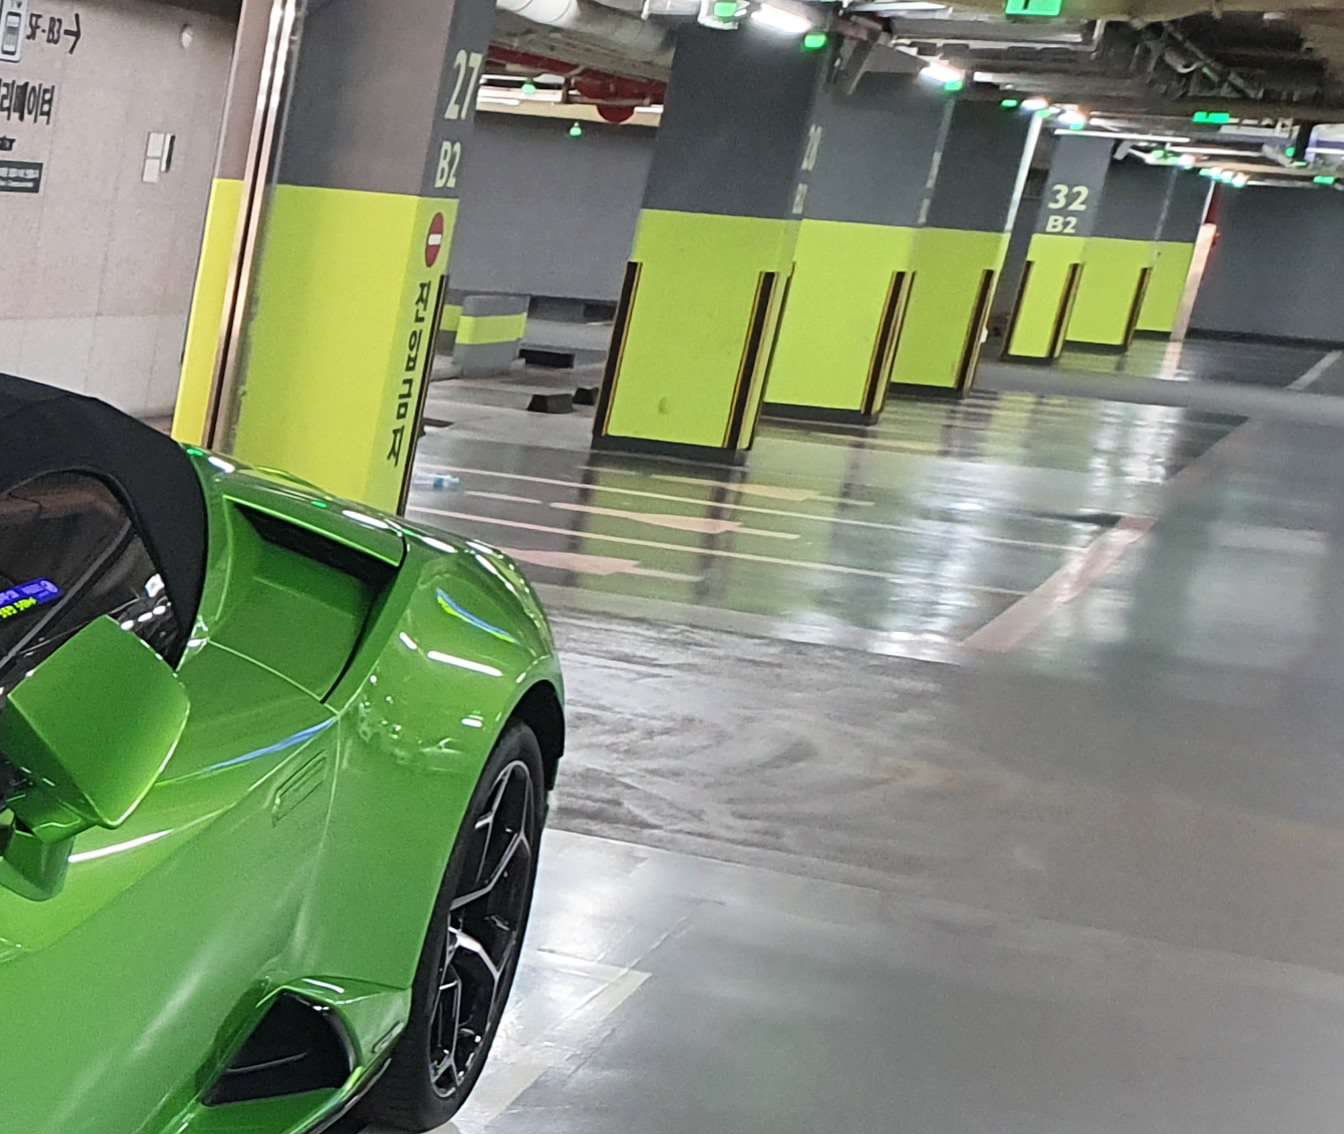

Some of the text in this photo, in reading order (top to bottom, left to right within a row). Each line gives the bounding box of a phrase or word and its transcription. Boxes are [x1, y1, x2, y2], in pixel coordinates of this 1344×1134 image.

[444, 49, 483, 120] 27
[434, 140, 461, 188] B2
[1048, 183, 1089, 211] 32
[1045, 215, 1078, 233] B2
[387, 280, 431, 467] 진입금지
